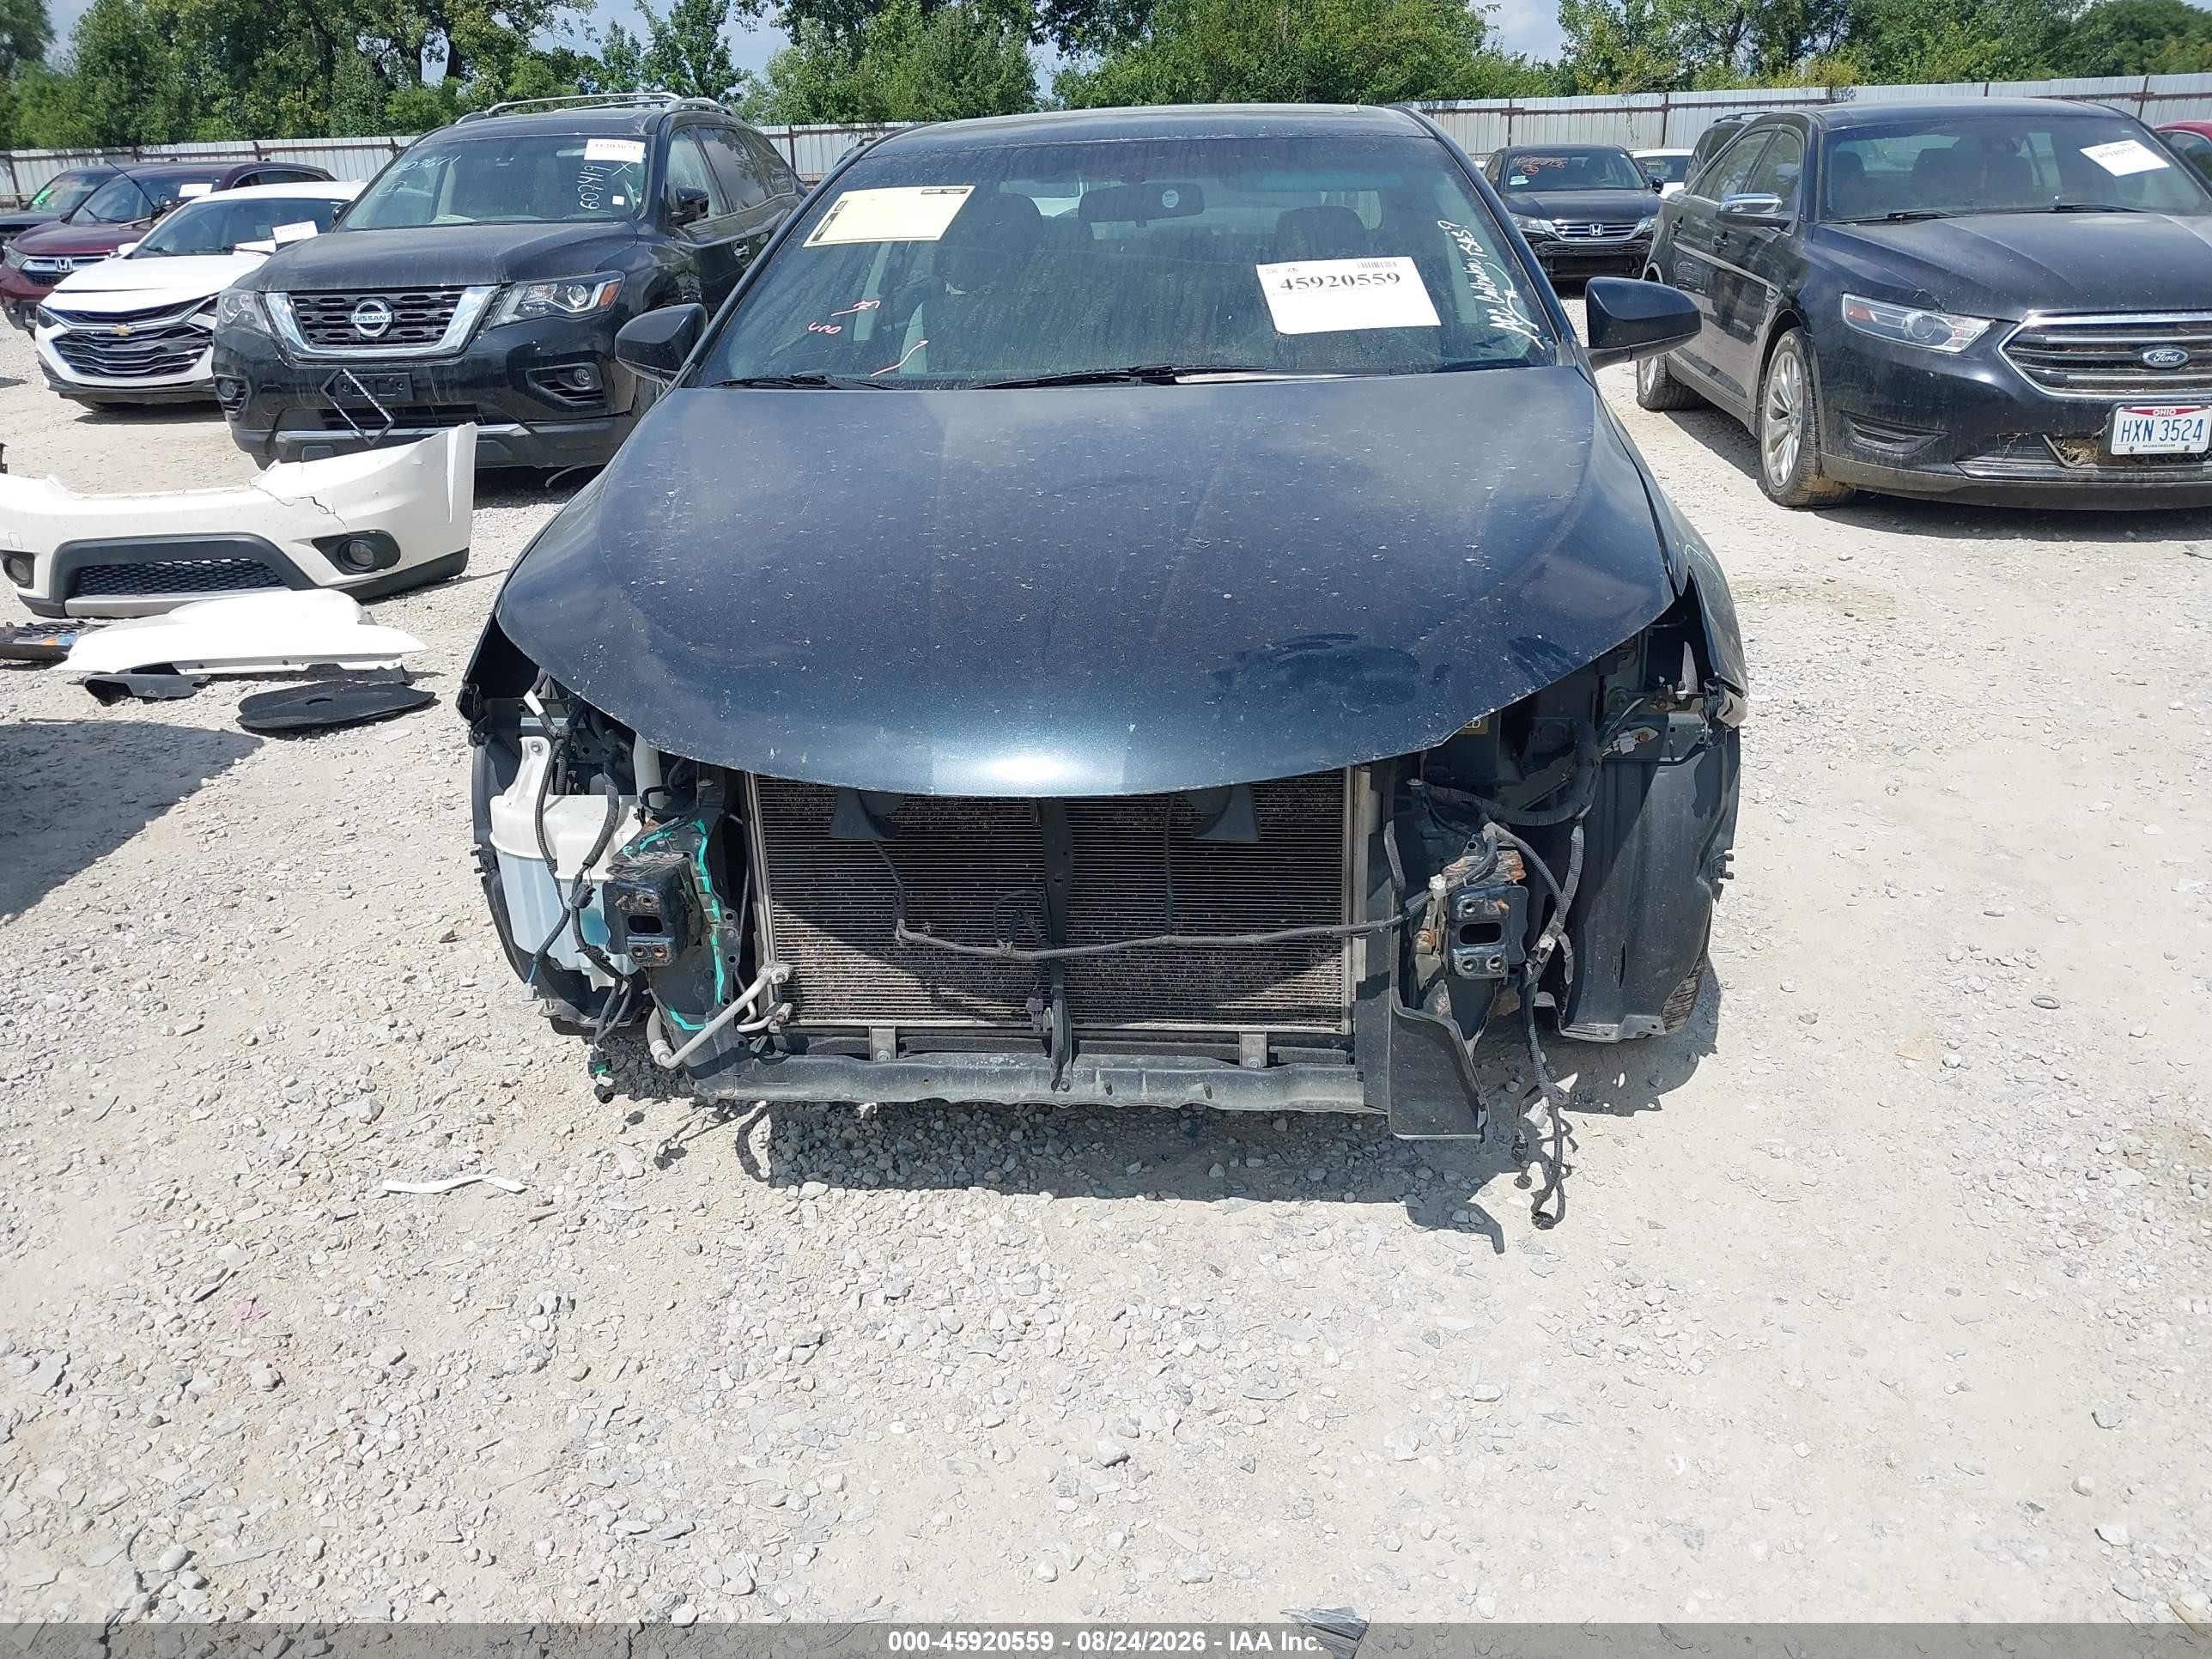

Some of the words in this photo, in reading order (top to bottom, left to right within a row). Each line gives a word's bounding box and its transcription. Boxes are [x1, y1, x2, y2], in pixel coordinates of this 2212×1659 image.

[1280, 272, 1401, 290] 45920559
[2153, 351, 2180, 362] Ford
[2121, 419, 2154, 442] HXN
[2159, 419, 2204, 441] 3524
